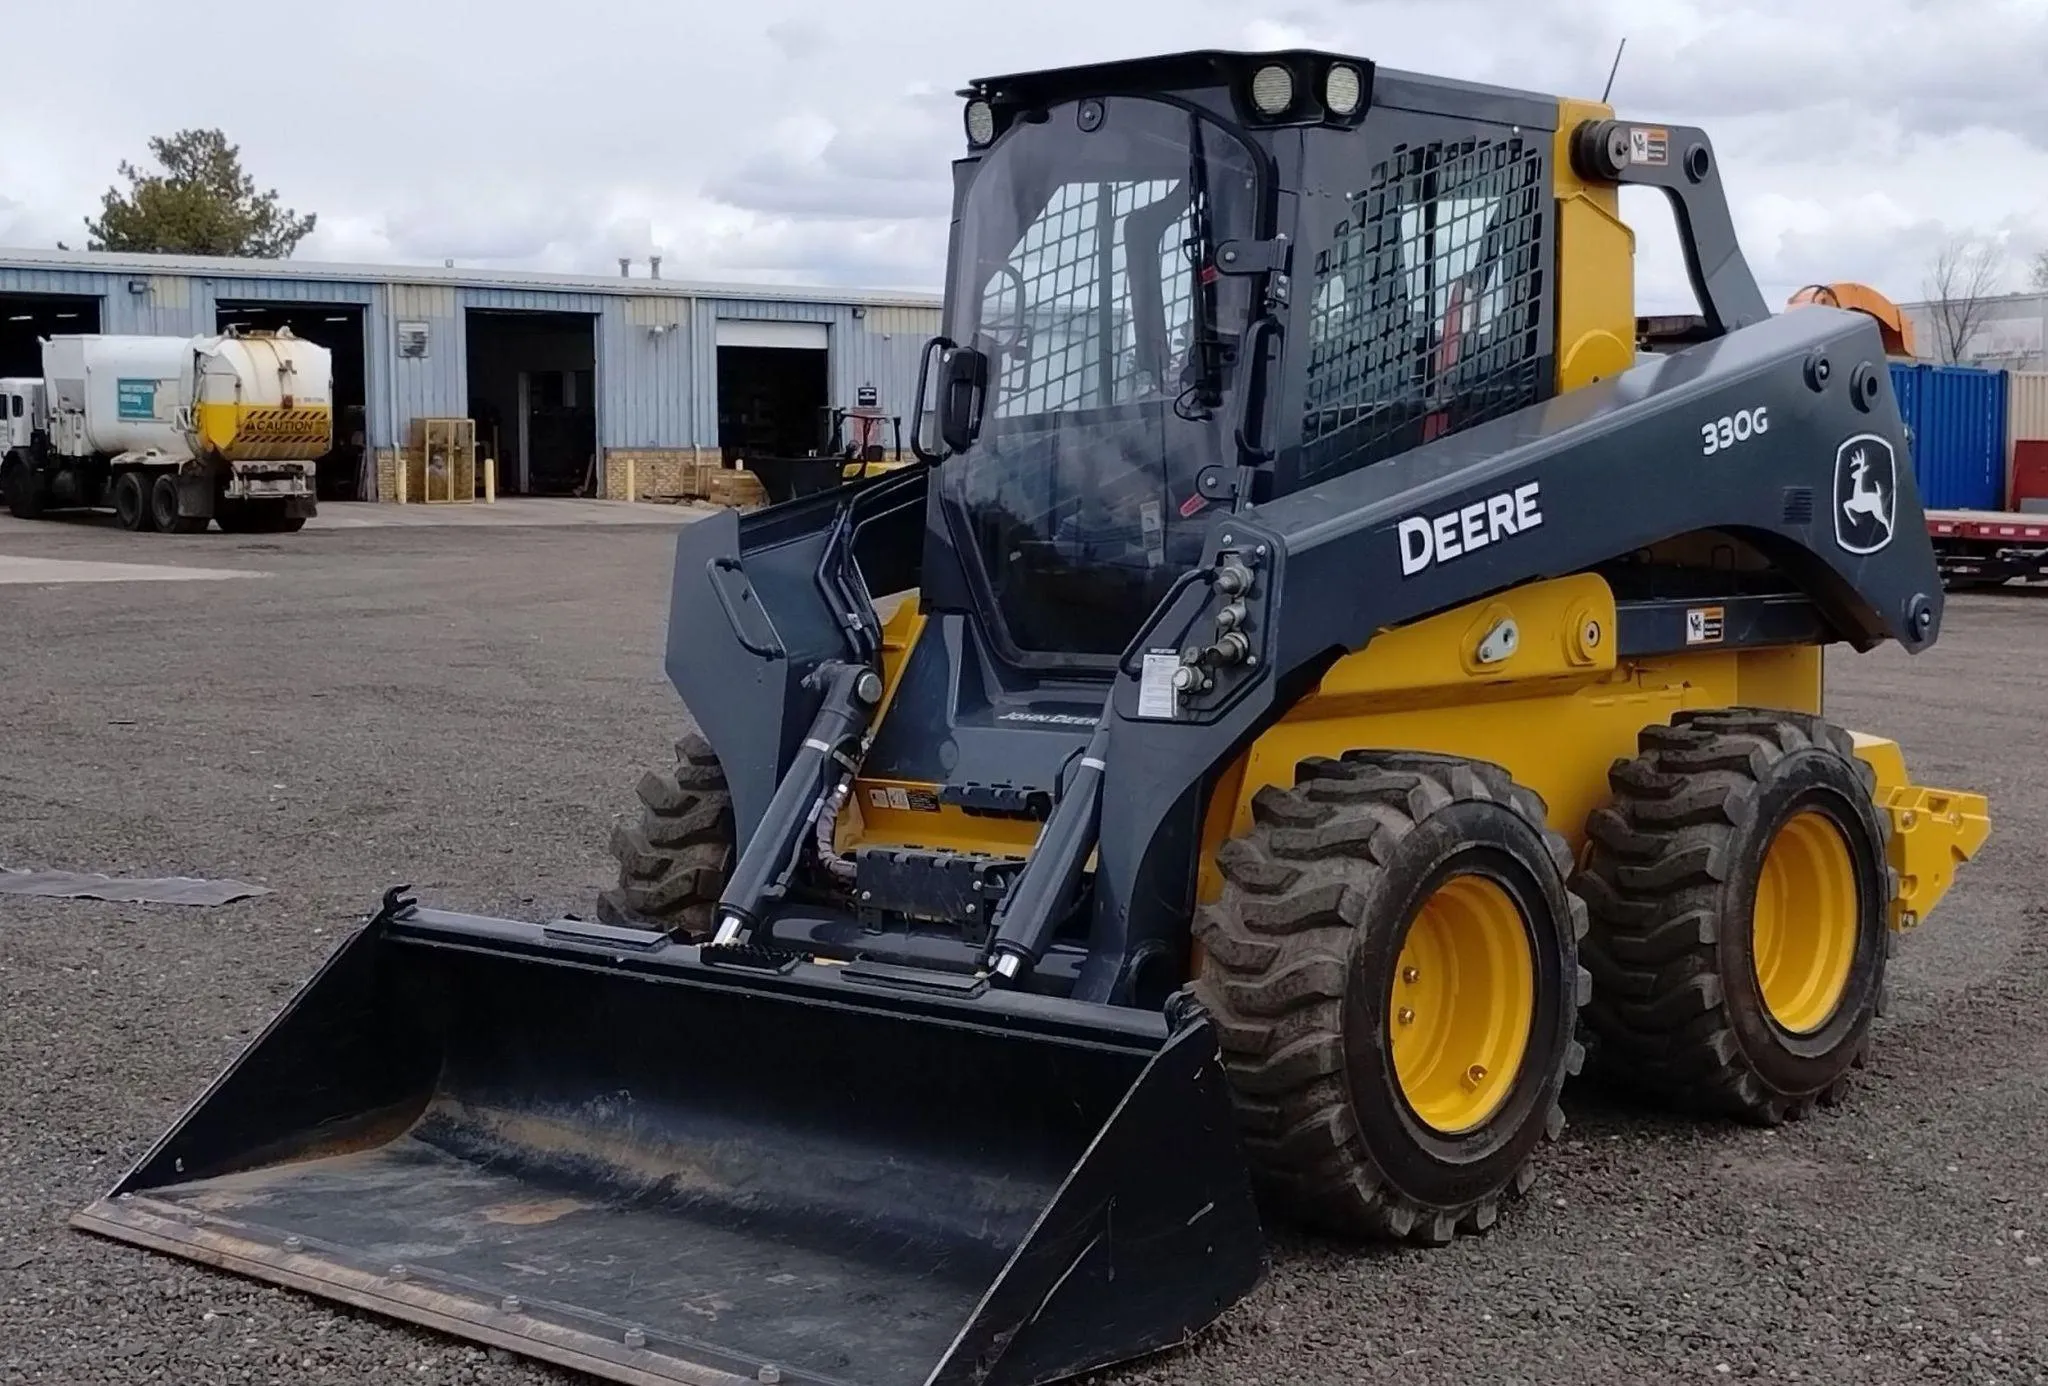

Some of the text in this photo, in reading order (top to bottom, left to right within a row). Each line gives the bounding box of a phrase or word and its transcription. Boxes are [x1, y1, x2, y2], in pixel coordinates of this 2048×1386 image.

[257, 420, 313, 432] CAUTION
[1701, 406, 1768, 455] 330G
[1398, 482, 1543, 576] DEERE
[998, 712, 1100, 725] JOHN DEER
